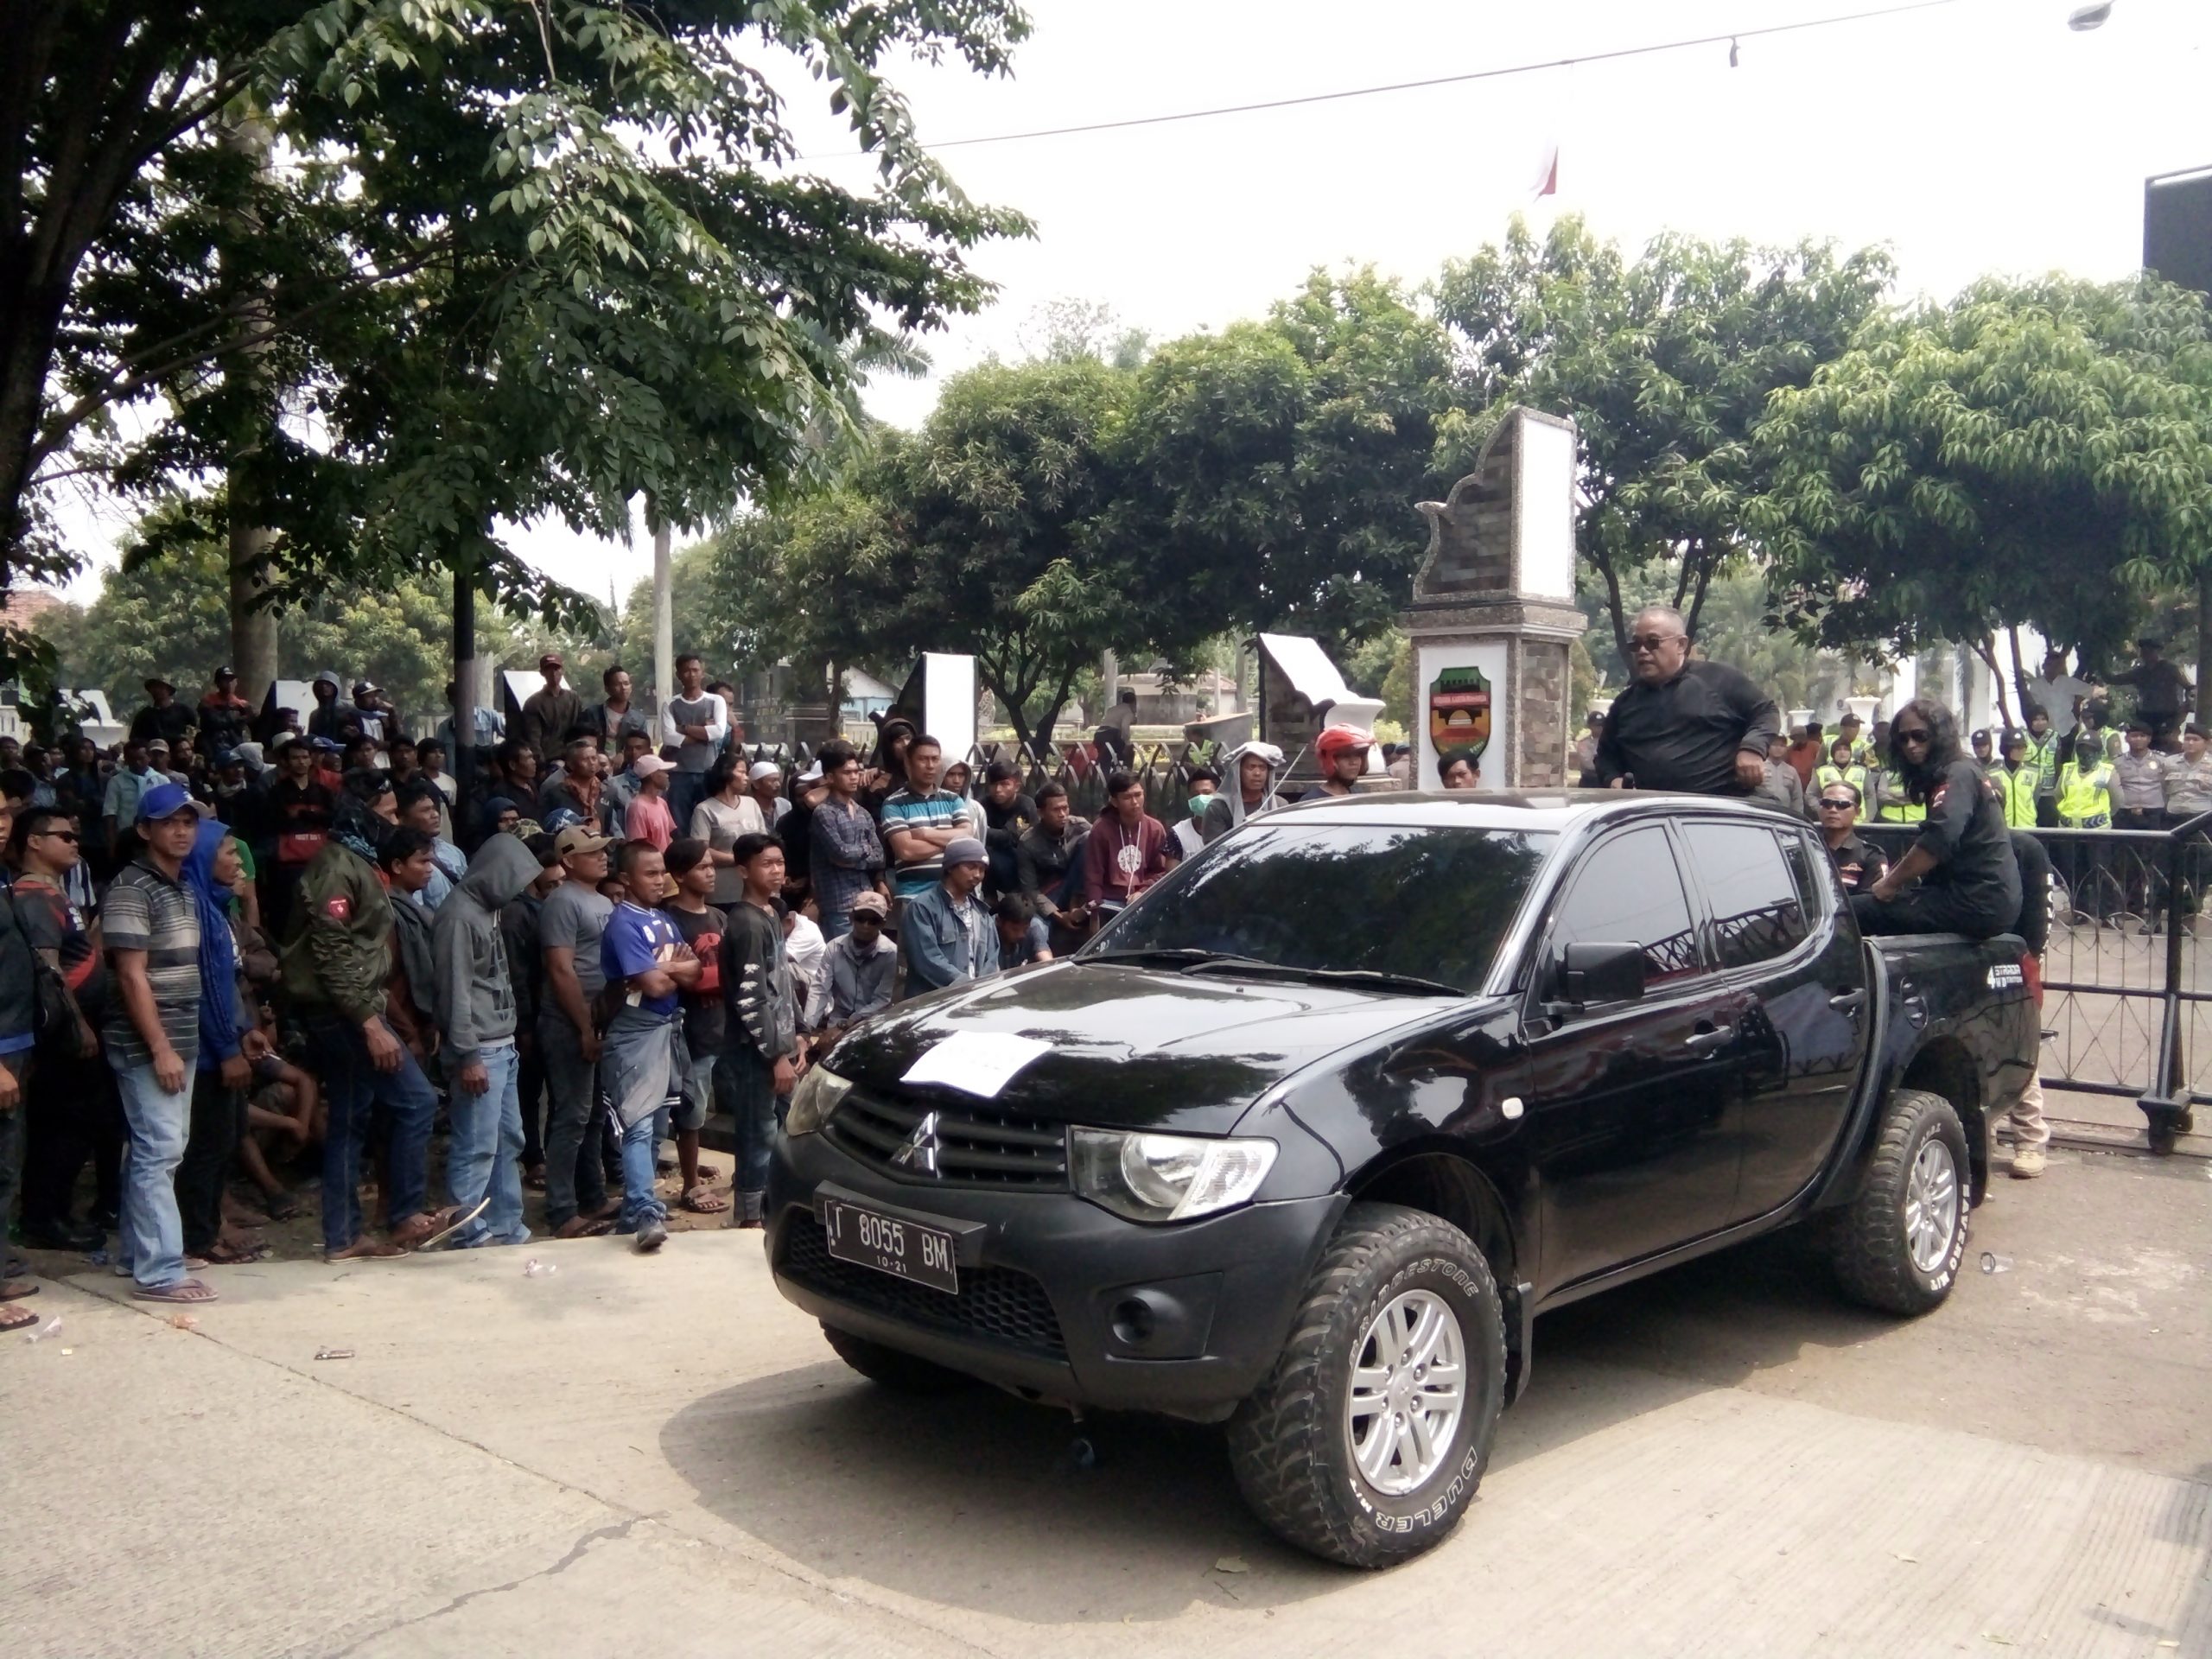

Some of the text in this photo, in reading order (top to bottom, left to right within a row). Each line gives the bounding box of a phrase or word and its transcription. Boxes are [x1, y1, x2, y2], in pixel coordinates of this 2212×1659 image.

[859, 1213, 906, 1257] 8055
[921, 1232, 949, 1272] BM
[1376, 1445, 1478, 1533] DUELER
